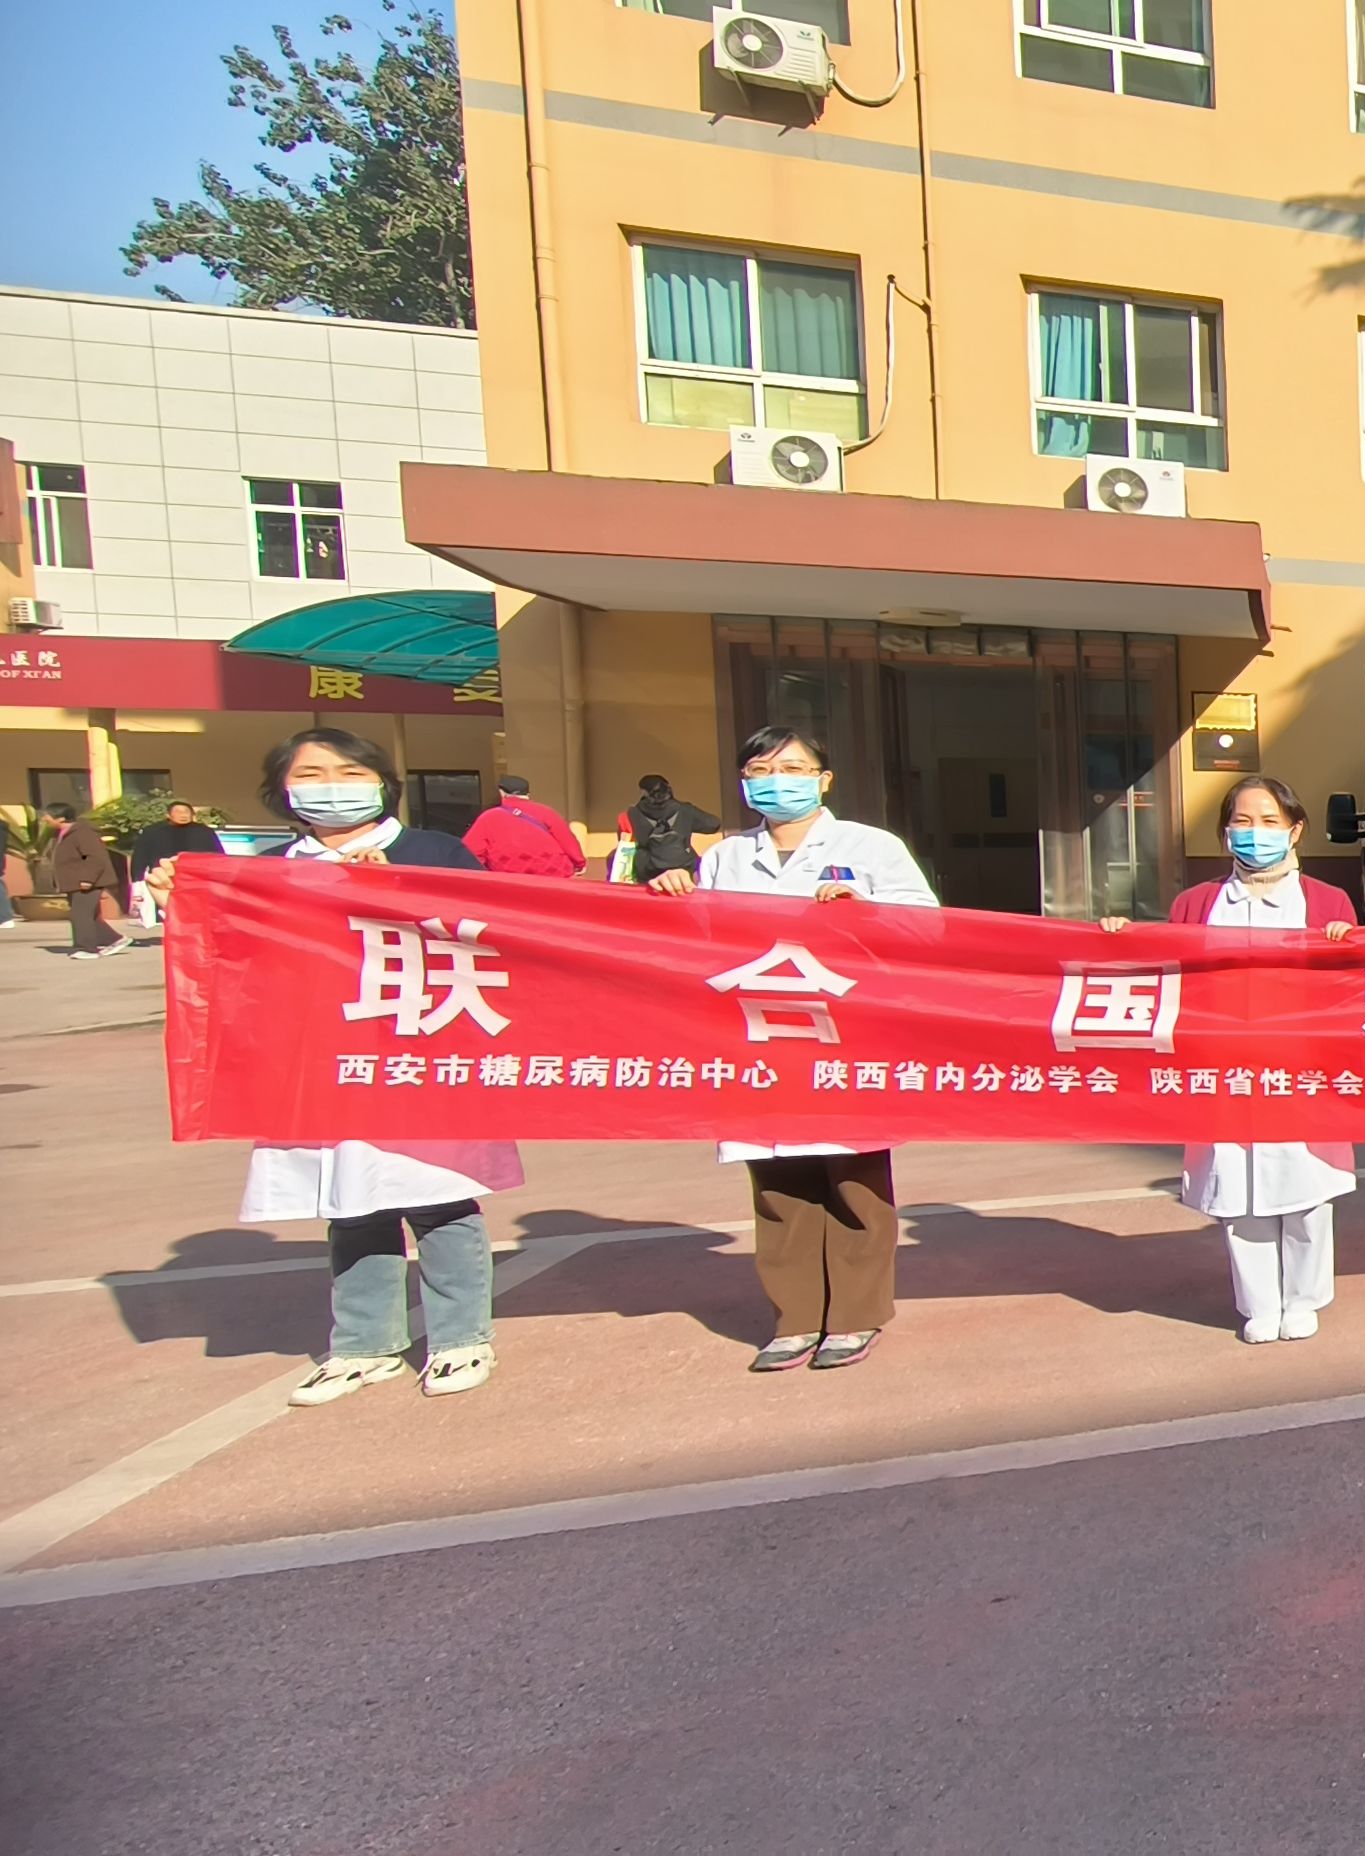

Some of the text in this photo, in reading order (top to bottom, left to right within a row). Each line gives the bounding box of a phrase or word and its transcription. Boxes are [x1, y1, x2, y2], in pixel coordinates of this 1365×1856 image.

[0, 650, 61, 667] 医院
[337, 1053, 779, 1090] 西安市糖尿病防治中心
[812, 1059, 1119, 1094] 陕西省内分泌学会
